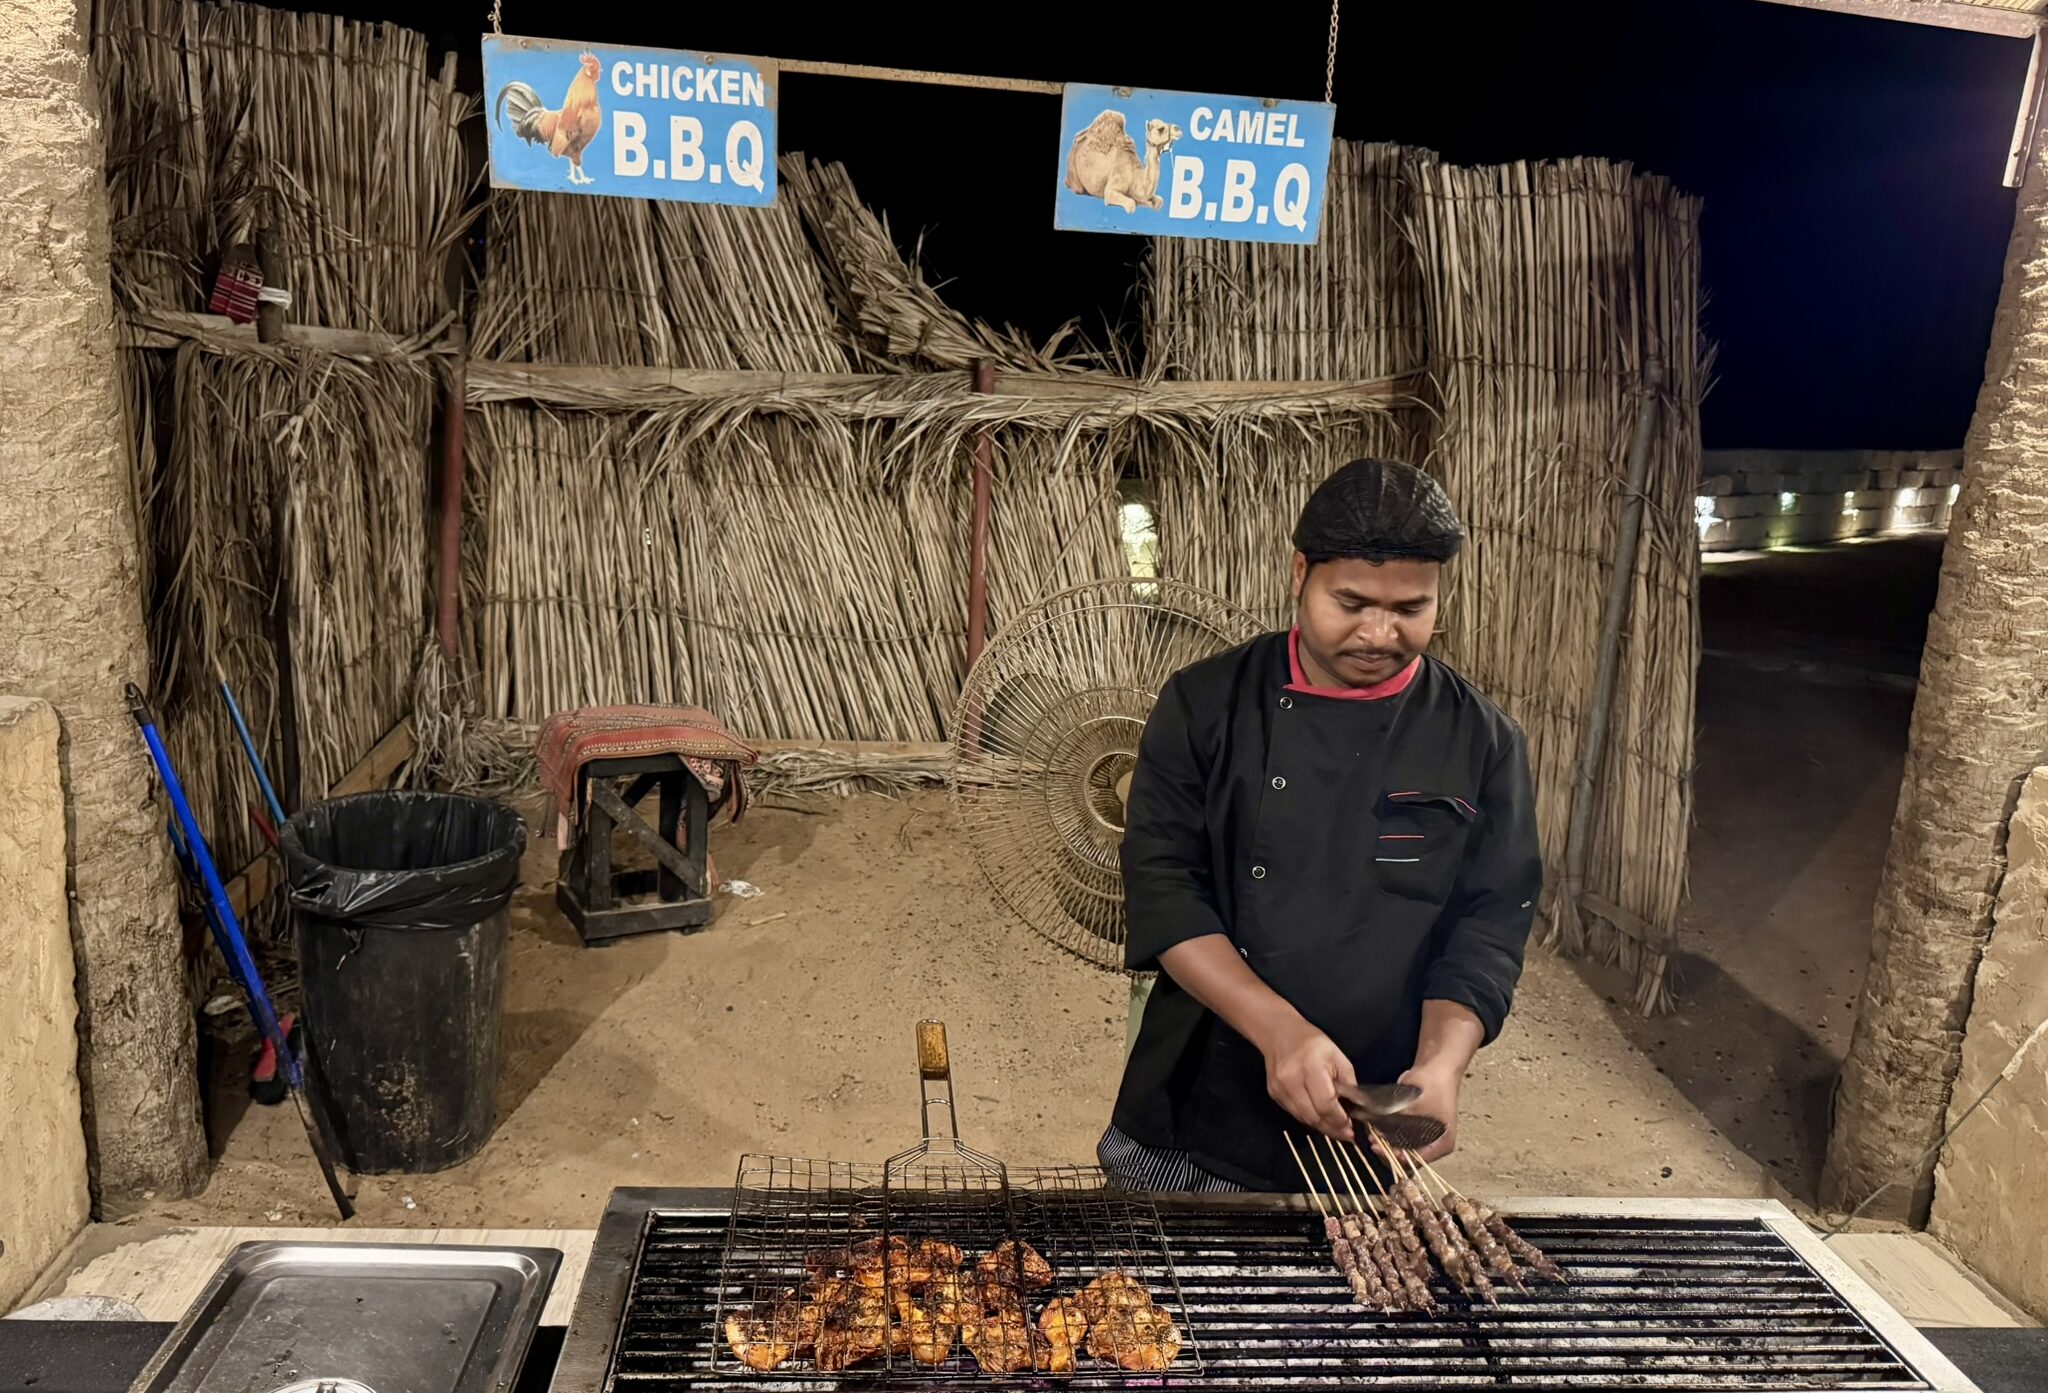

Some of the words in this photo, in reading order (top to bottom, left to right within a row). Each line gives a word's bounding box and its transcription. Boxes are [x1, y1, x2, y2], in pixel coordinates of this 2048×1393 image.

[611, 61, 765, 107] CHICKEN
[612, 110, 765, 193] B.B.Q
[1189, 106, 1305, 148] CAMEL
[1168, 155, 1311, 234] B.B.Q
